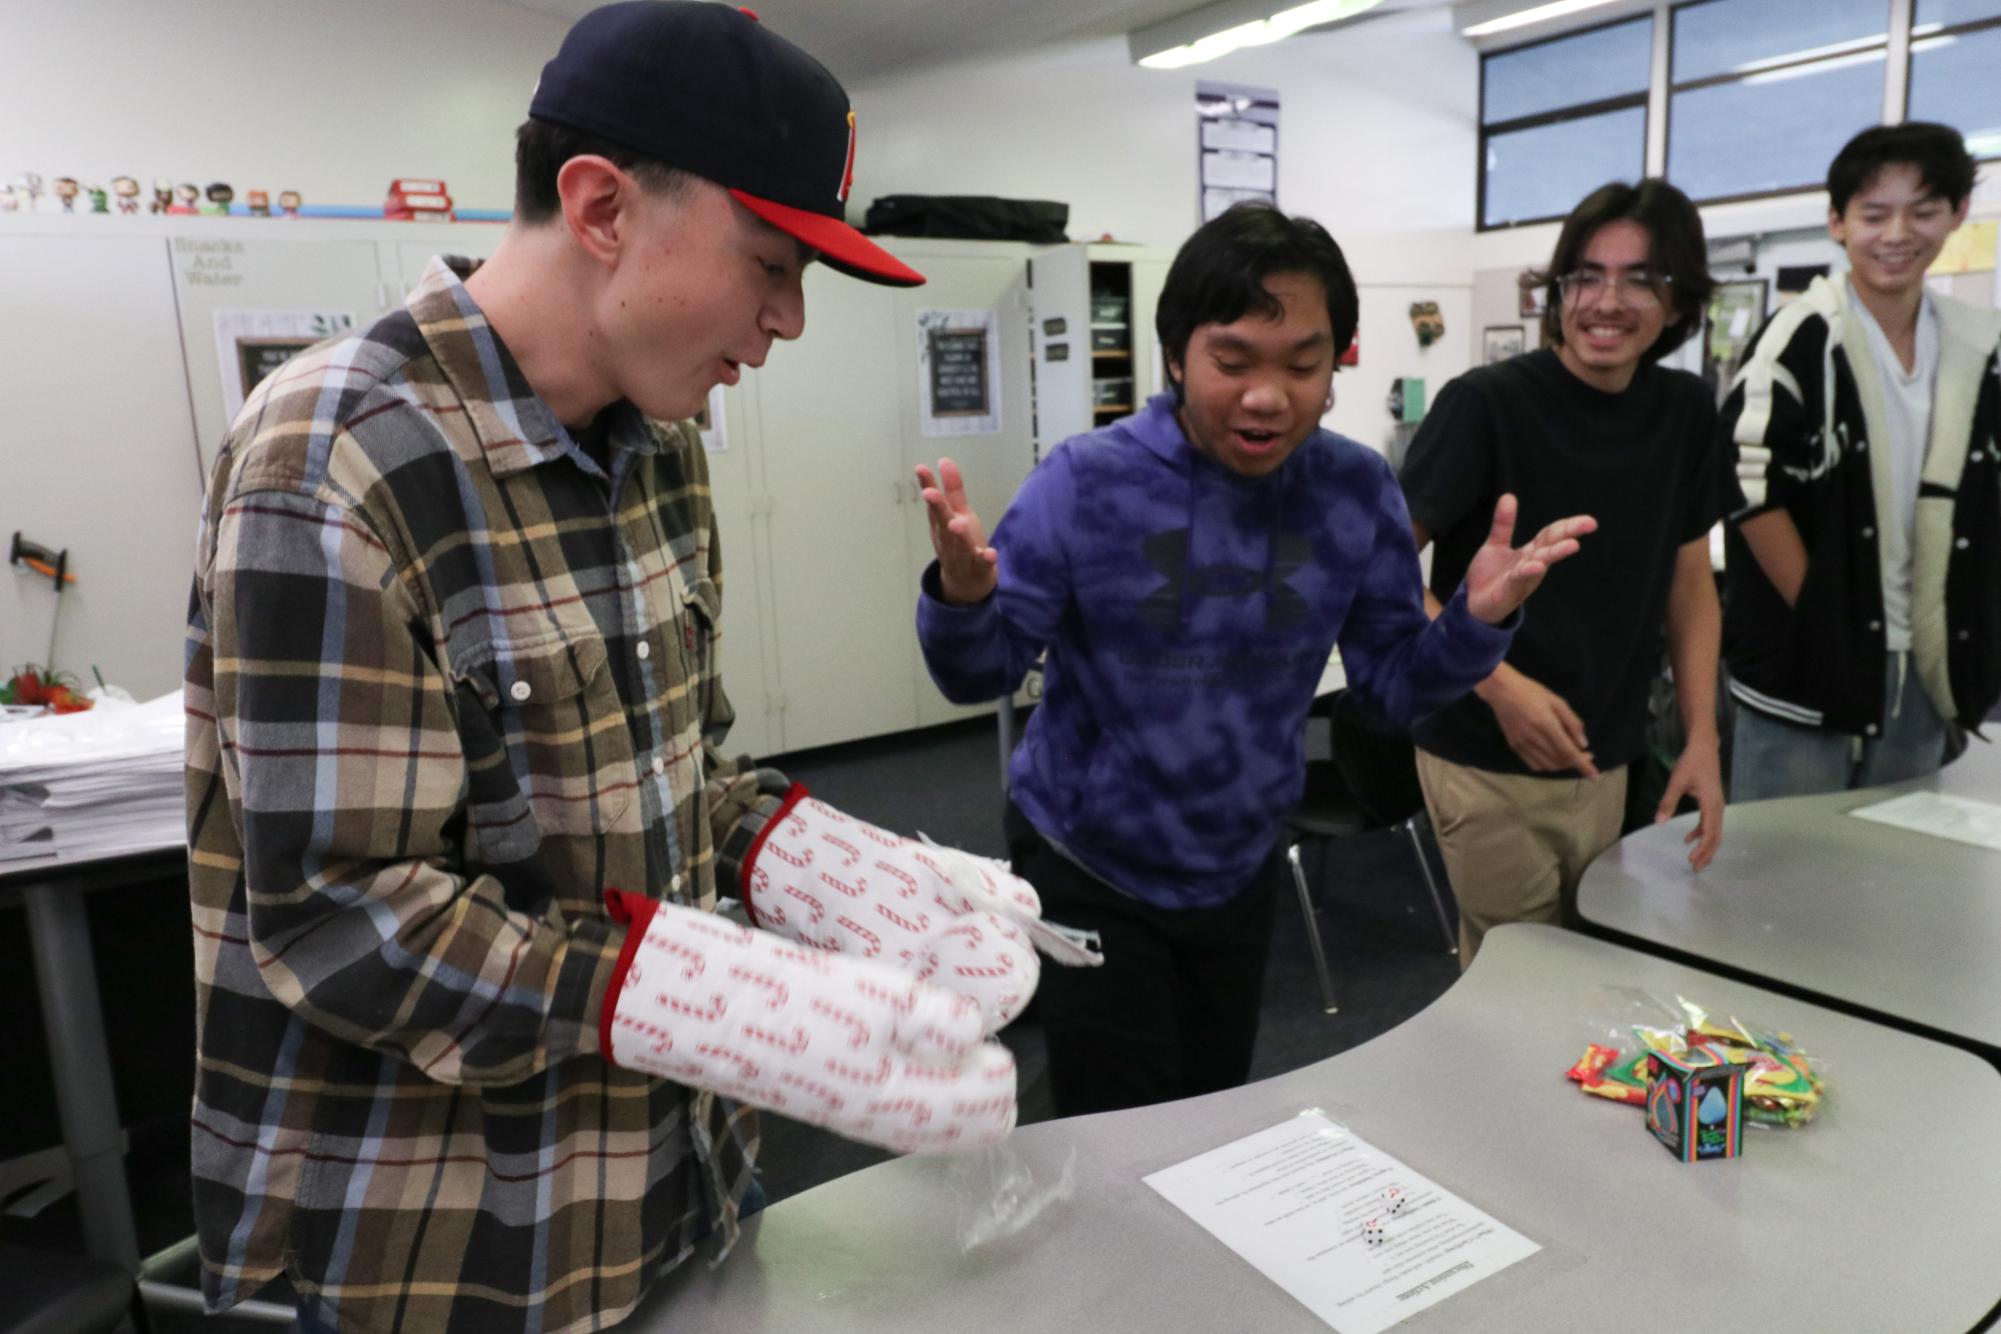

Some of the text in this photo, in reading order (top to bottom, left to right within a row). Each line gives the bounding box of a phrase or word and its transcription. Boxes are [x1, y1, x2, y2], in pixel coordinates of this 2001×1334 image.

[175, 238, 244, 254] Snacks
[192, 255, 232, 269] And
[184, 271, 243, 286] Water
